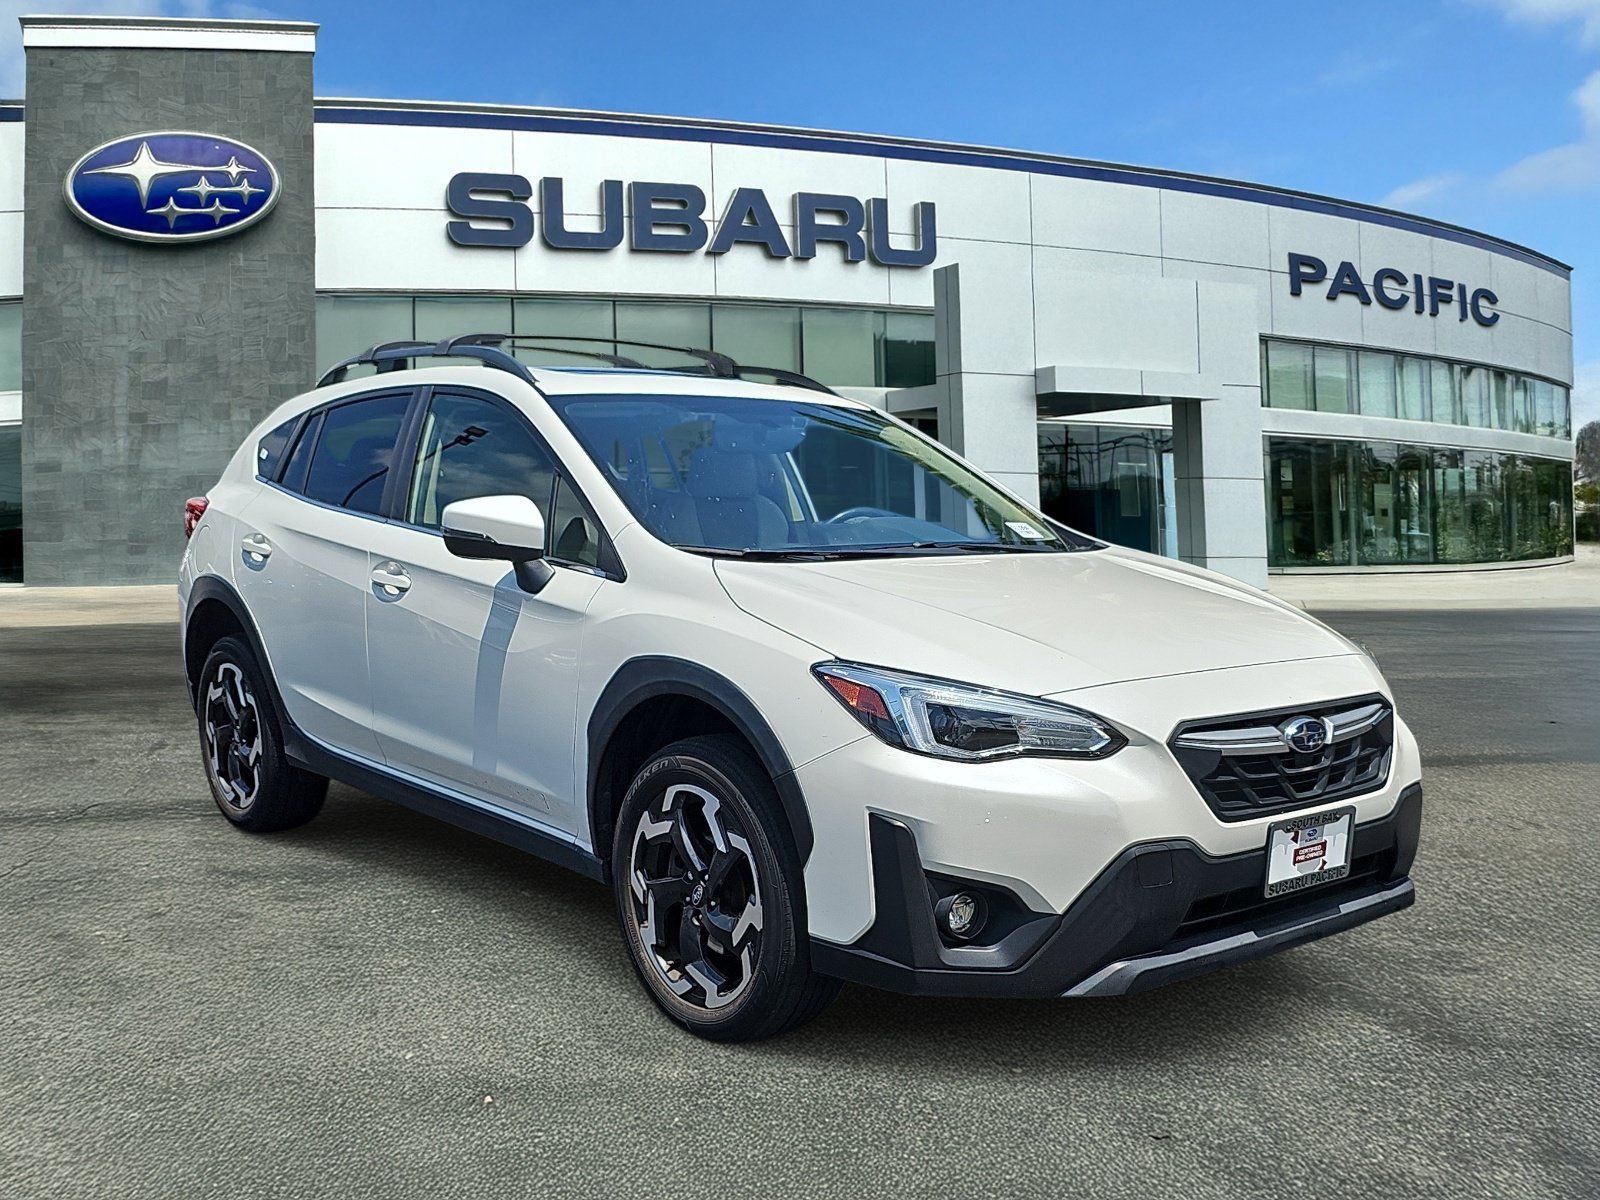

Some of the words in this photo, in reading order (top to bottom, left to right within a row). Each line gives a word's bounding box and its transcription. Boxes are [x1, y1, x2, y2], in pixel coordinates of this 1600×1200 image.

[447, 171, 938, 268] SUBARU
[1288, 252, 1500, 327] PACIFIC
[1291, 816, 1320, 830] SOUTH
[1322, 811, 1338, 822] BAY
[1295, 850, 1323, 861] PRE-OWNED
[1298, 844, 1322, 855] CERTIFIED
[1268, 876, 1308, 896] SUBARU
[1311, 866, 1347, 883] PACIFIC
